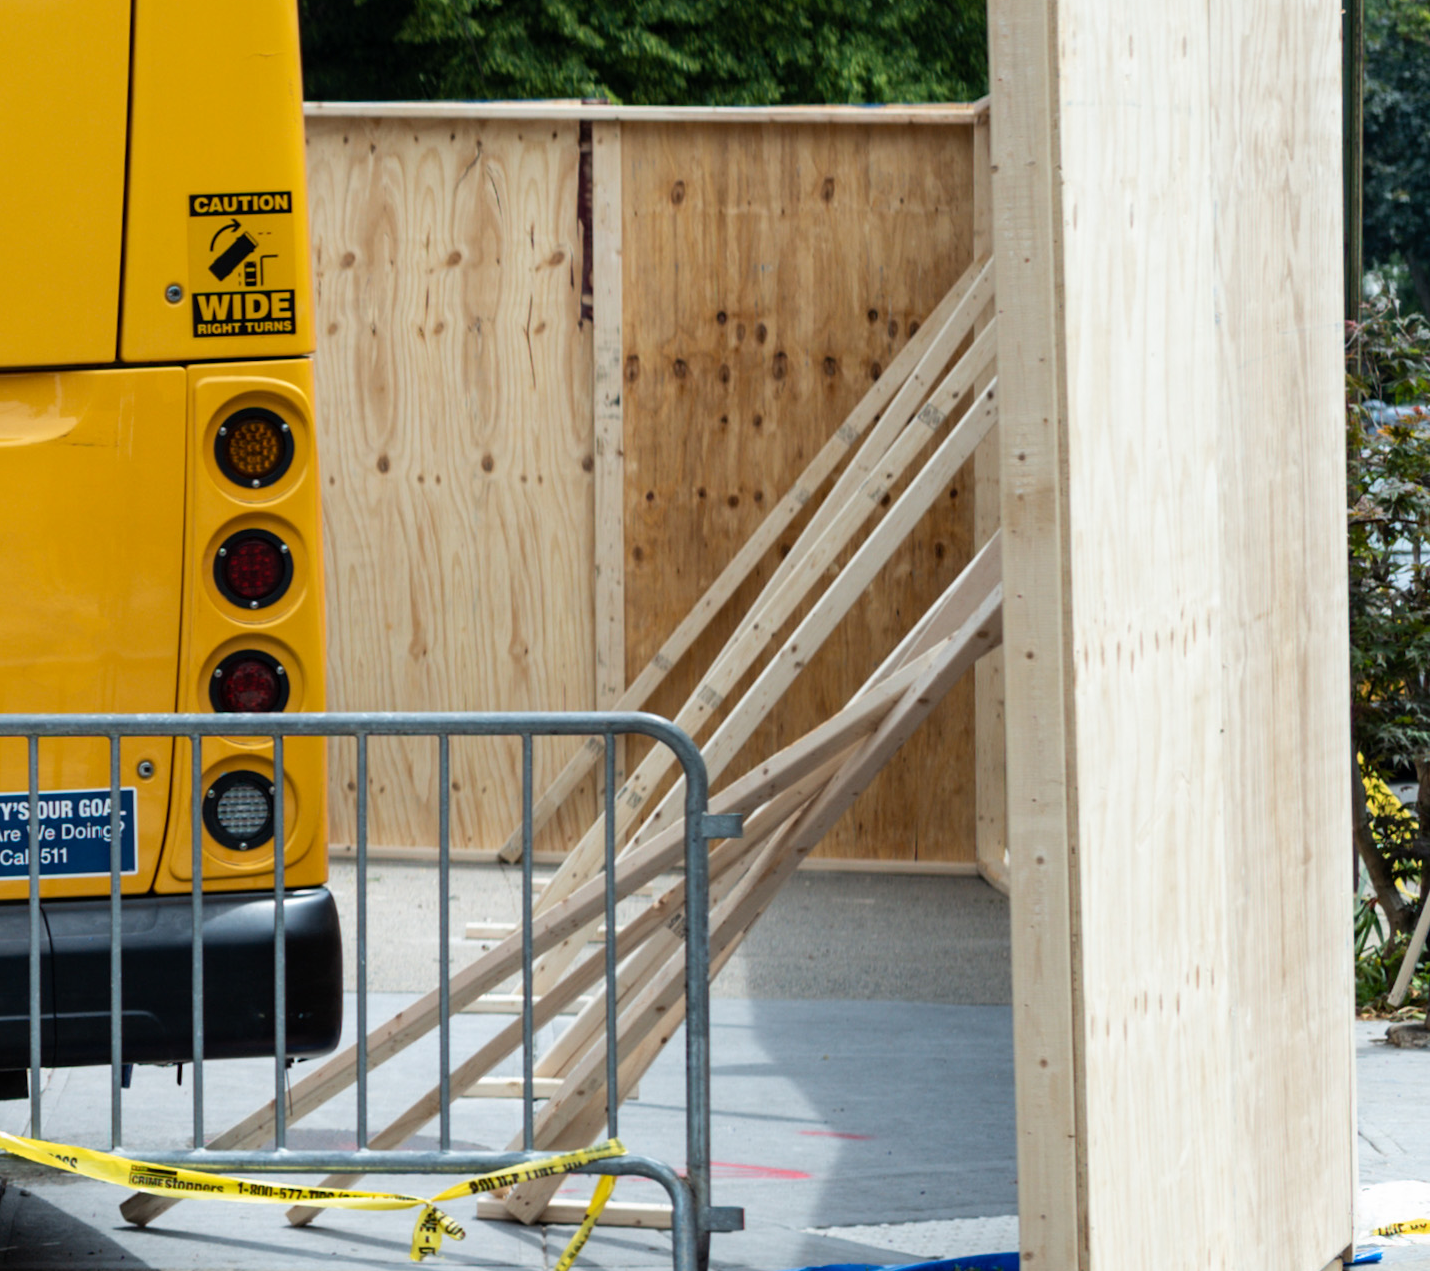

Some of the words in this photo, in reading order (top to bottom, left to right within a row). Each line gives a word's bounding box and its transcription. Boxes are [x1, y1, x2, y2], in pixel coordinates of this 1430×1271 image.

[194, 194, 289, 213] CAUTION
[197, 292, 292, 321] WIDE
[197, 323, 241, 334] RIGHT
[245, 321, 292, 333] TURNS
[37, 800, 74, 820] OUR
[40, 847, 68, 865] 511
